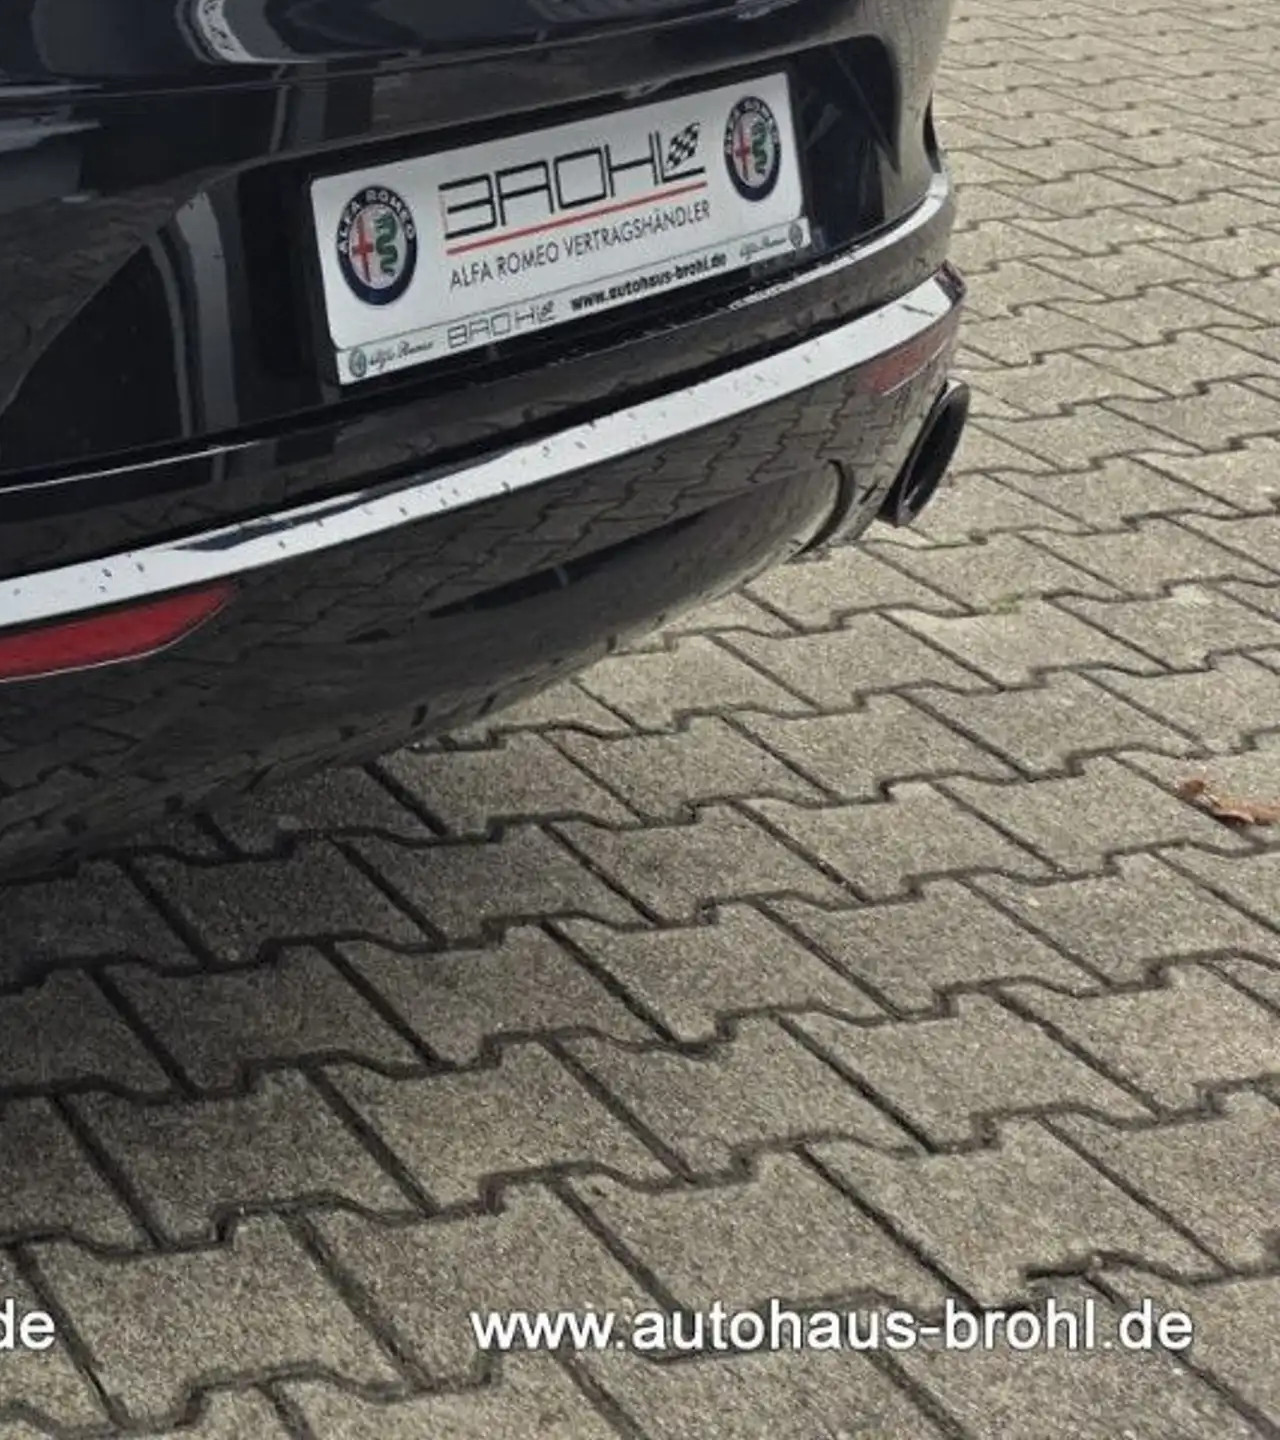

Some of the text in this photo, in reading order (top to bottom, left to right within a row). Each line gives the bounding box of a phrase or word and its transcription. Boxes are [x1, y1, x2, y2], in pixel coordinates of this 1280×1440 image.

[338, 189, 417, 254] ALFA ROMEO
[438, 129, 706, 241] BROHL
[450, 199, 711, 292] ALFA ROMEO VERTRAGSHÄNDLER
